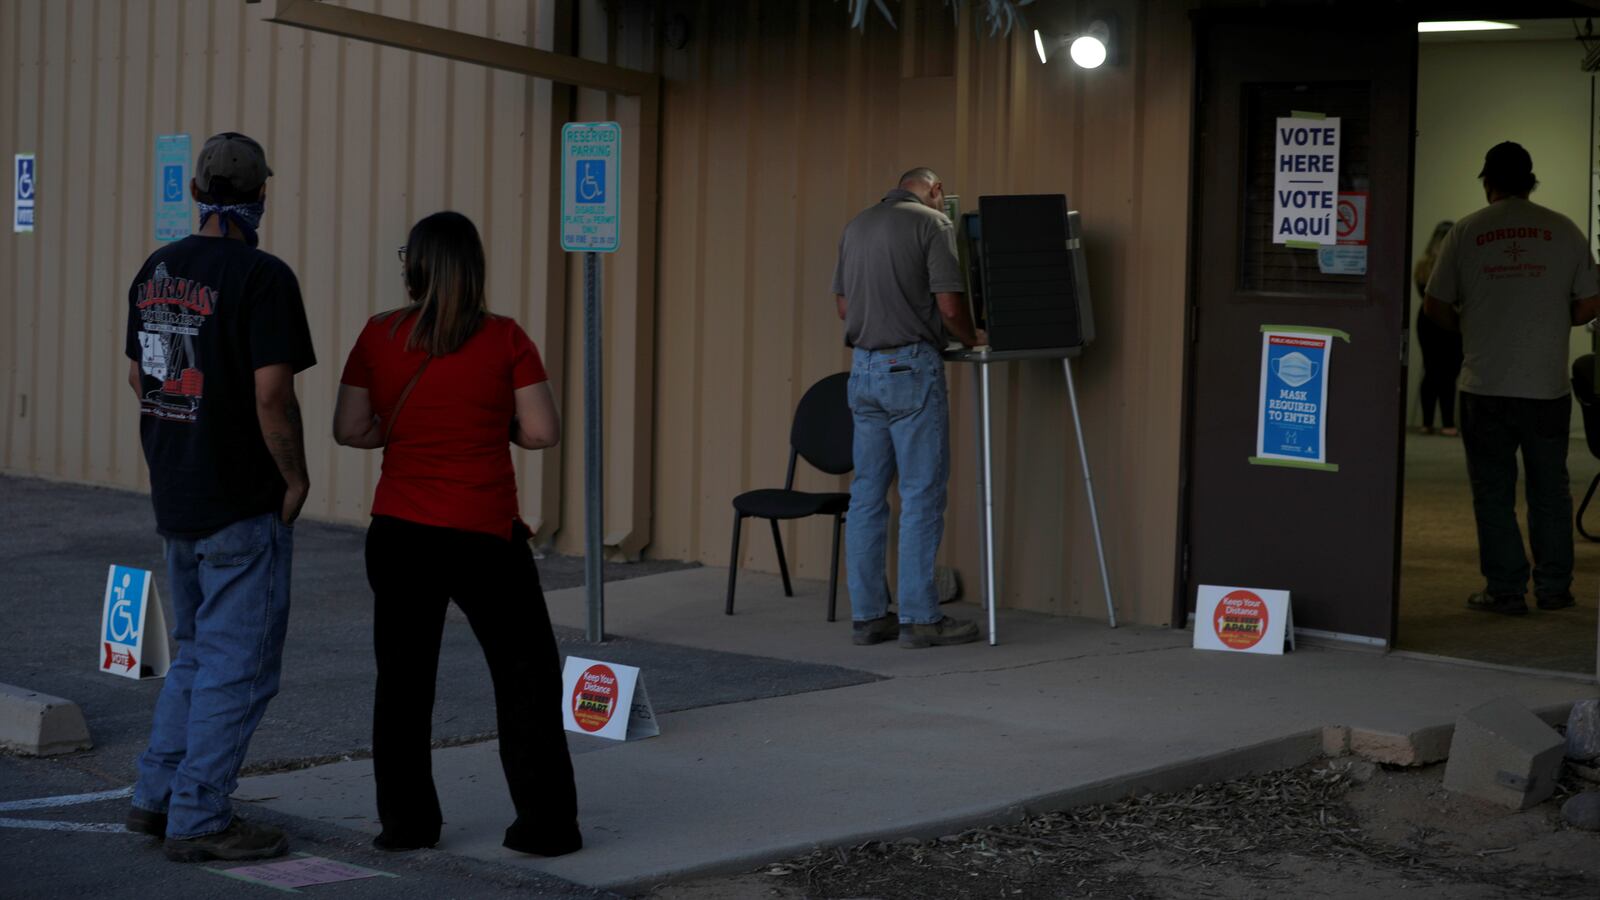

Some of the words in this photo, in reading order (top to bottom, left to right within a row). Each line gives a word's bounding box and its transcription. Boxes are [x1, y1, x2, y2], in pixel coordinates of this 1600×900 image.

[567, 130, 614, 142] RESERVED
[1281, 128, 1335, 146] VOTE
[571, 145, 610, 156] PARKING
[1280, 155, 1334, 172] HERE
[1279, 190, 1333, 208] VOTE
[1279, 214, 1330, 236] AQUÍ
[1476, 227, 1552, 246] GORDON'S
[1280, 389, 1308, 400] MASK
[1269, 400, 1317, 413] REQUIRED
[1268, 410, 1282, 420] TO
[1284, 412, 1316, 425] ENTER
[1223, 597, 1242, 606] Keep
[1243, 598, 1261, 607] Your
[1225, 606, 1258, 616] Distance
[1225, 622, 1258, 632] APART
[583, 671, 600, 682] Keep
[600, 673, 615, 684] Your
[584, 682, 611, 694] Distance
[578, 700, 608, 713] APART
